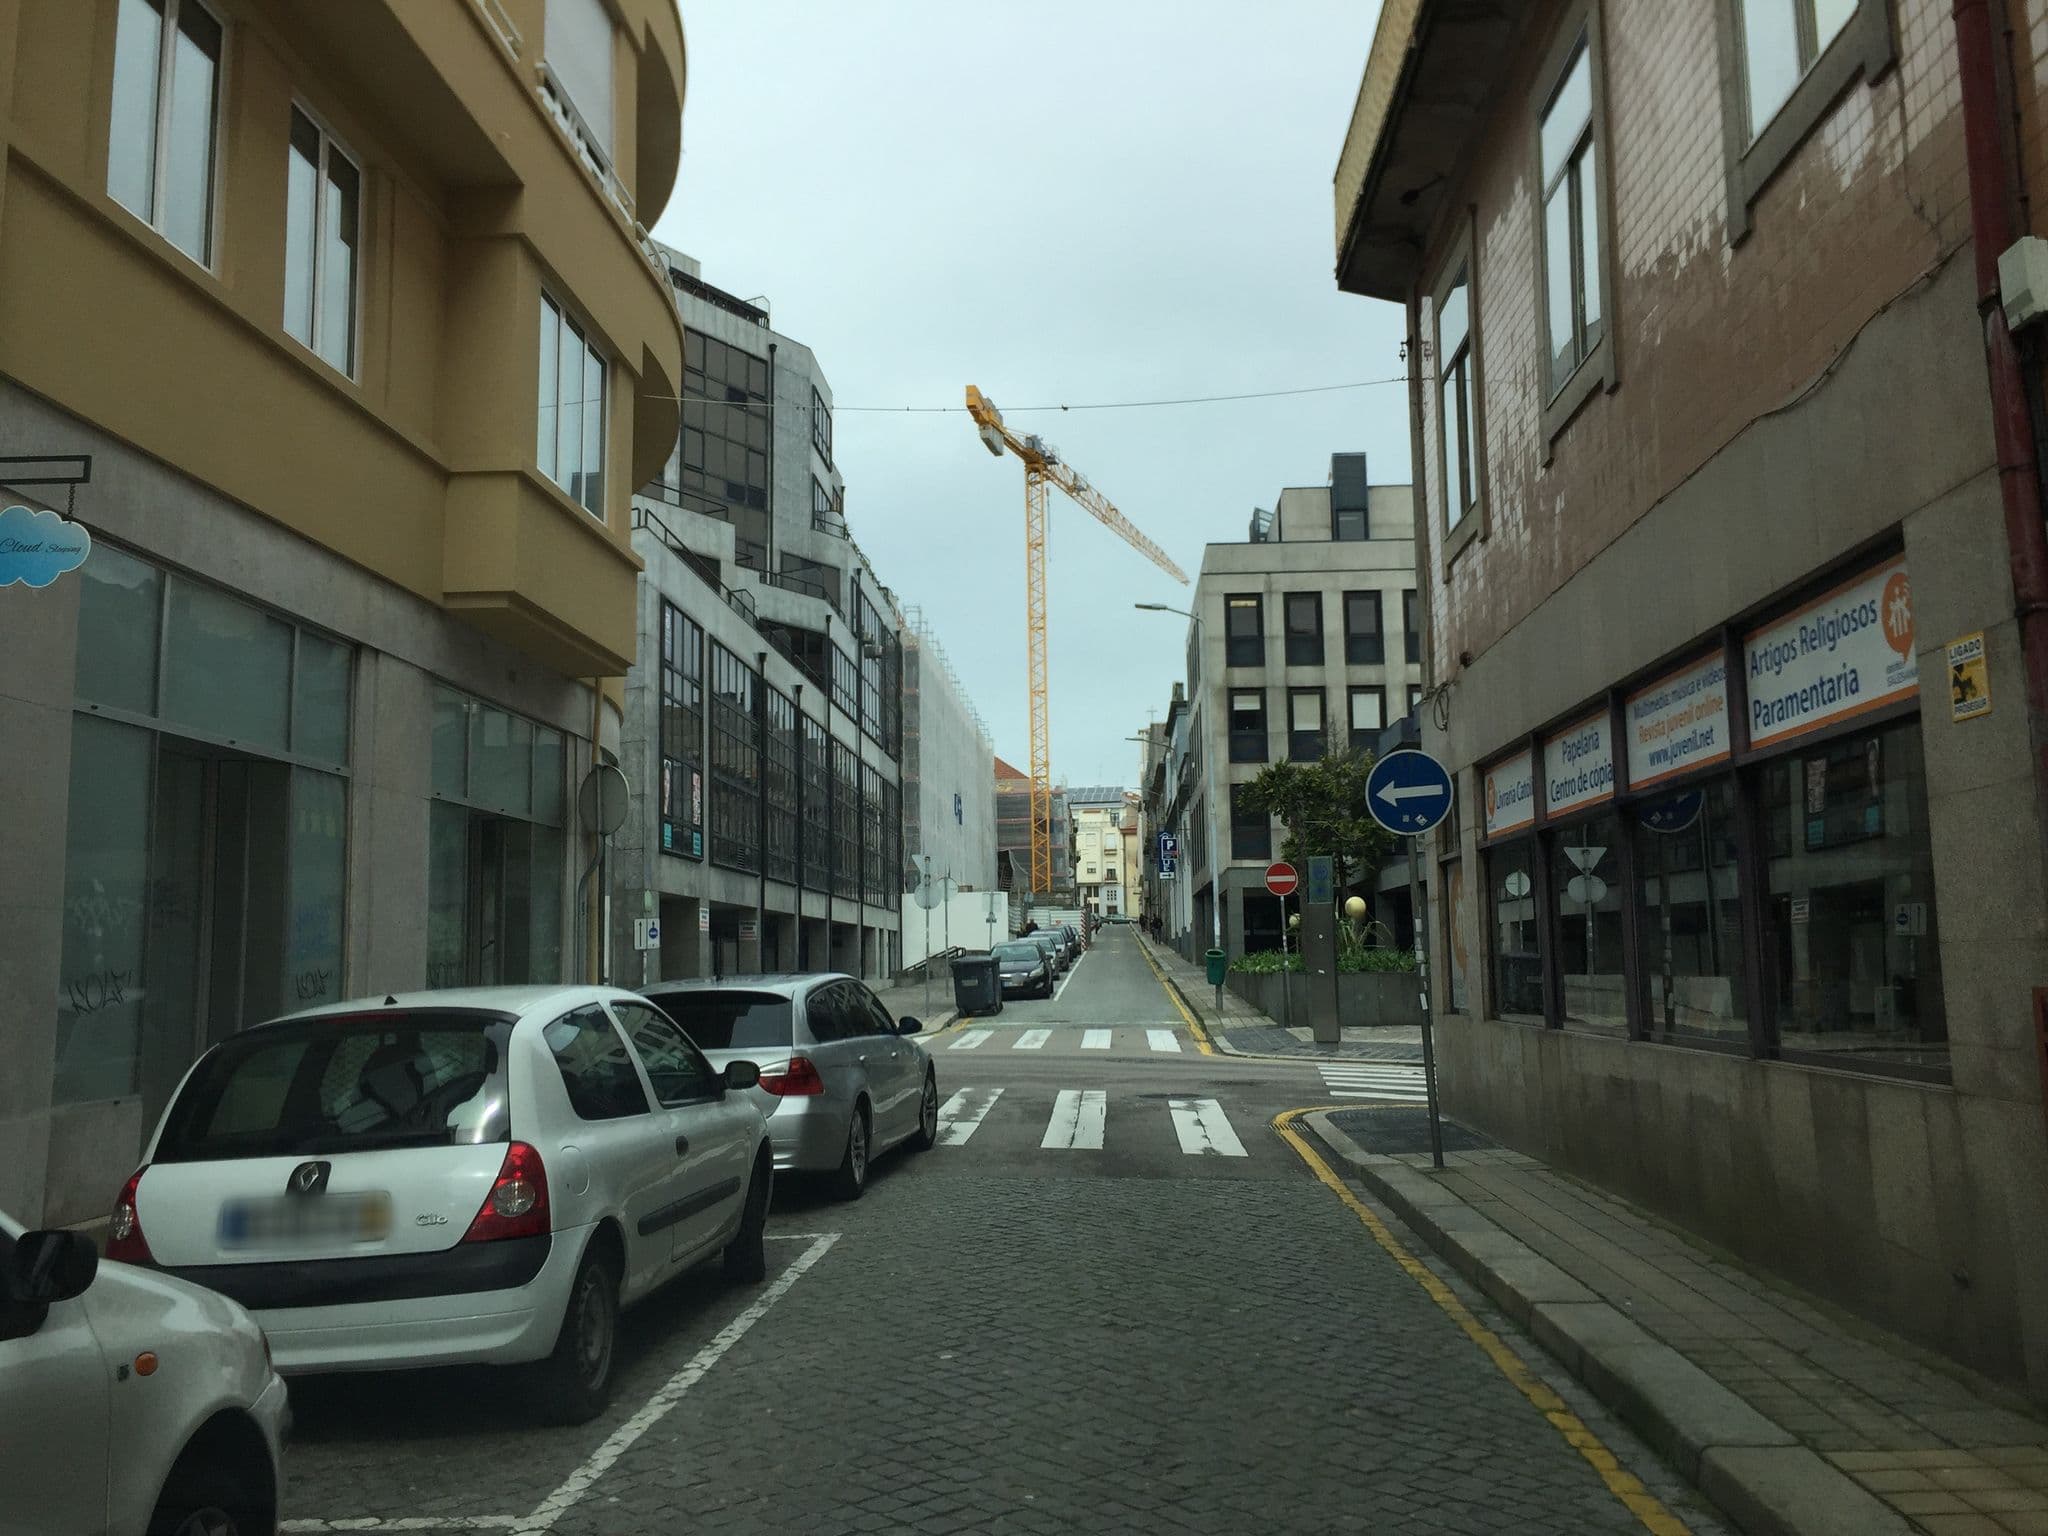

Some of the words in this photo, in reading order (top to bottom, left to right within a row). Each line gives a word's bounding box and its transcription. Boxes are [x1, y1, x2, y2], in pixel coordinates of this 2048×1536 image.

[0, 538, 42, 554] Cloud
[1751, 638, 1797, 679] Artigos
[1800, 599, 1878, 655] Religiosos
[1949, 638, 1981, 659] LIGADO
[1753, 662, 1860, 730] Paramentaria
[1639, 718, 1666, 744] Revista
[1666, 704, 1695, 737] juvenil
[1562, 727, 1600, 767] Papelaria
[1649, 726, 1715, 766] www.juvenil.net
[1551, 776, 1577, 803] Centro
[1578, 767, 1589, 793] de
[1167, 840, 1174, 849] P
[416, 1213, 448, 1226] Clio
